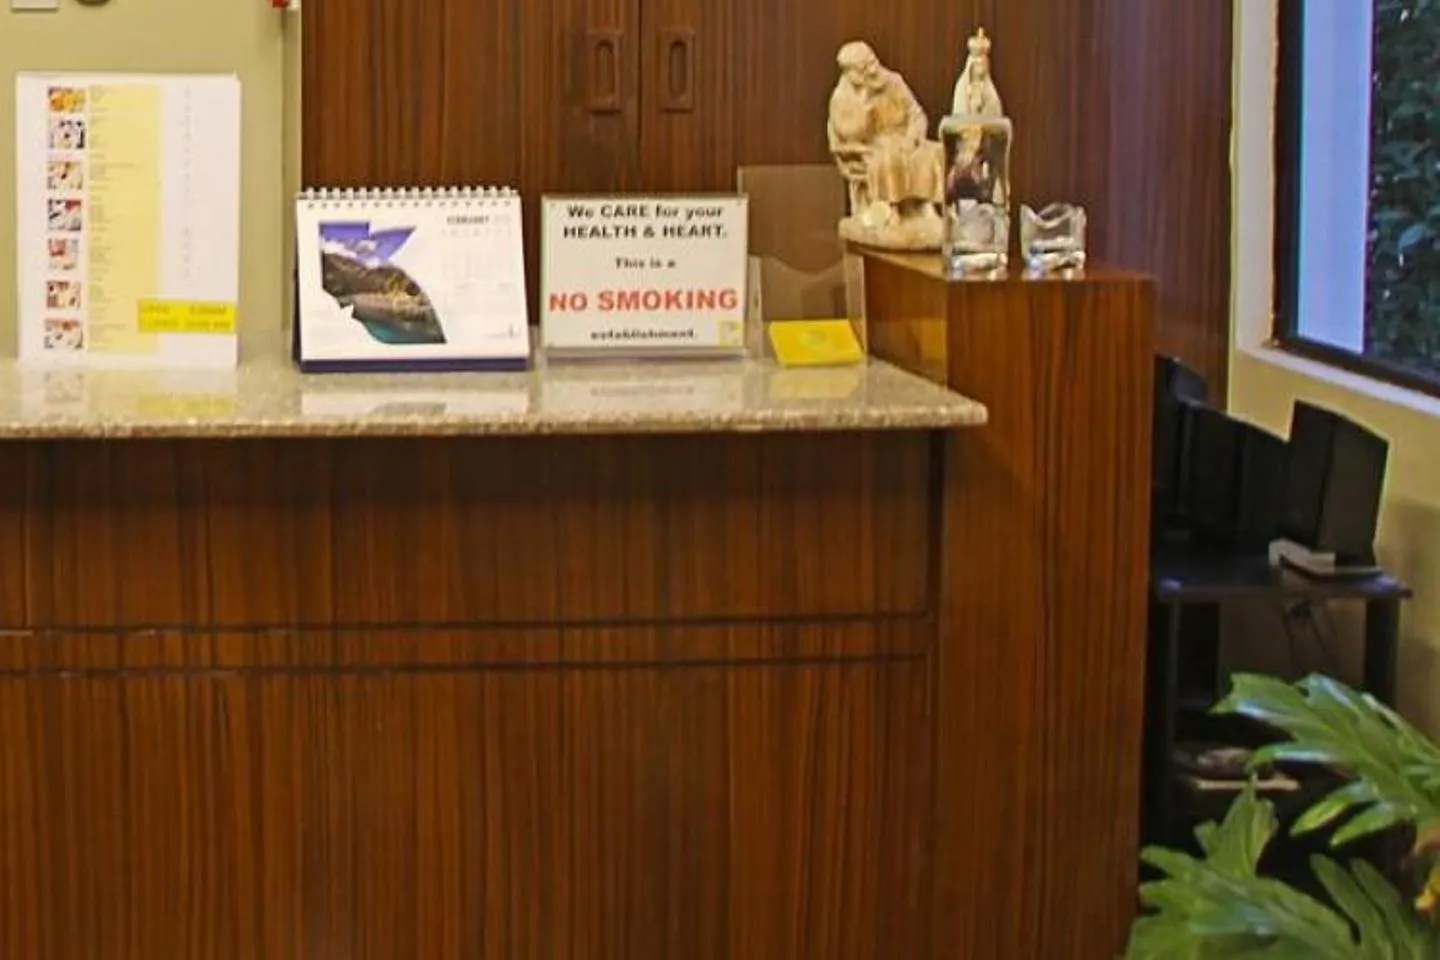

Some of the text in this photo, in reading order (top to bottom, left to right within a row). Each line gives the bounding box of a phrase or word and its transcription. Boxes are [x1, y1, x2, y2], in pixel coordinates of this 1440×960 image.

[567, 204, 725, 221] We CARE for your
[563, 223, 728, 239] HEALTH & HEART.
[615, 257, 676, 269] This is a
[549, 289, 739, 312] NO SMOKING
